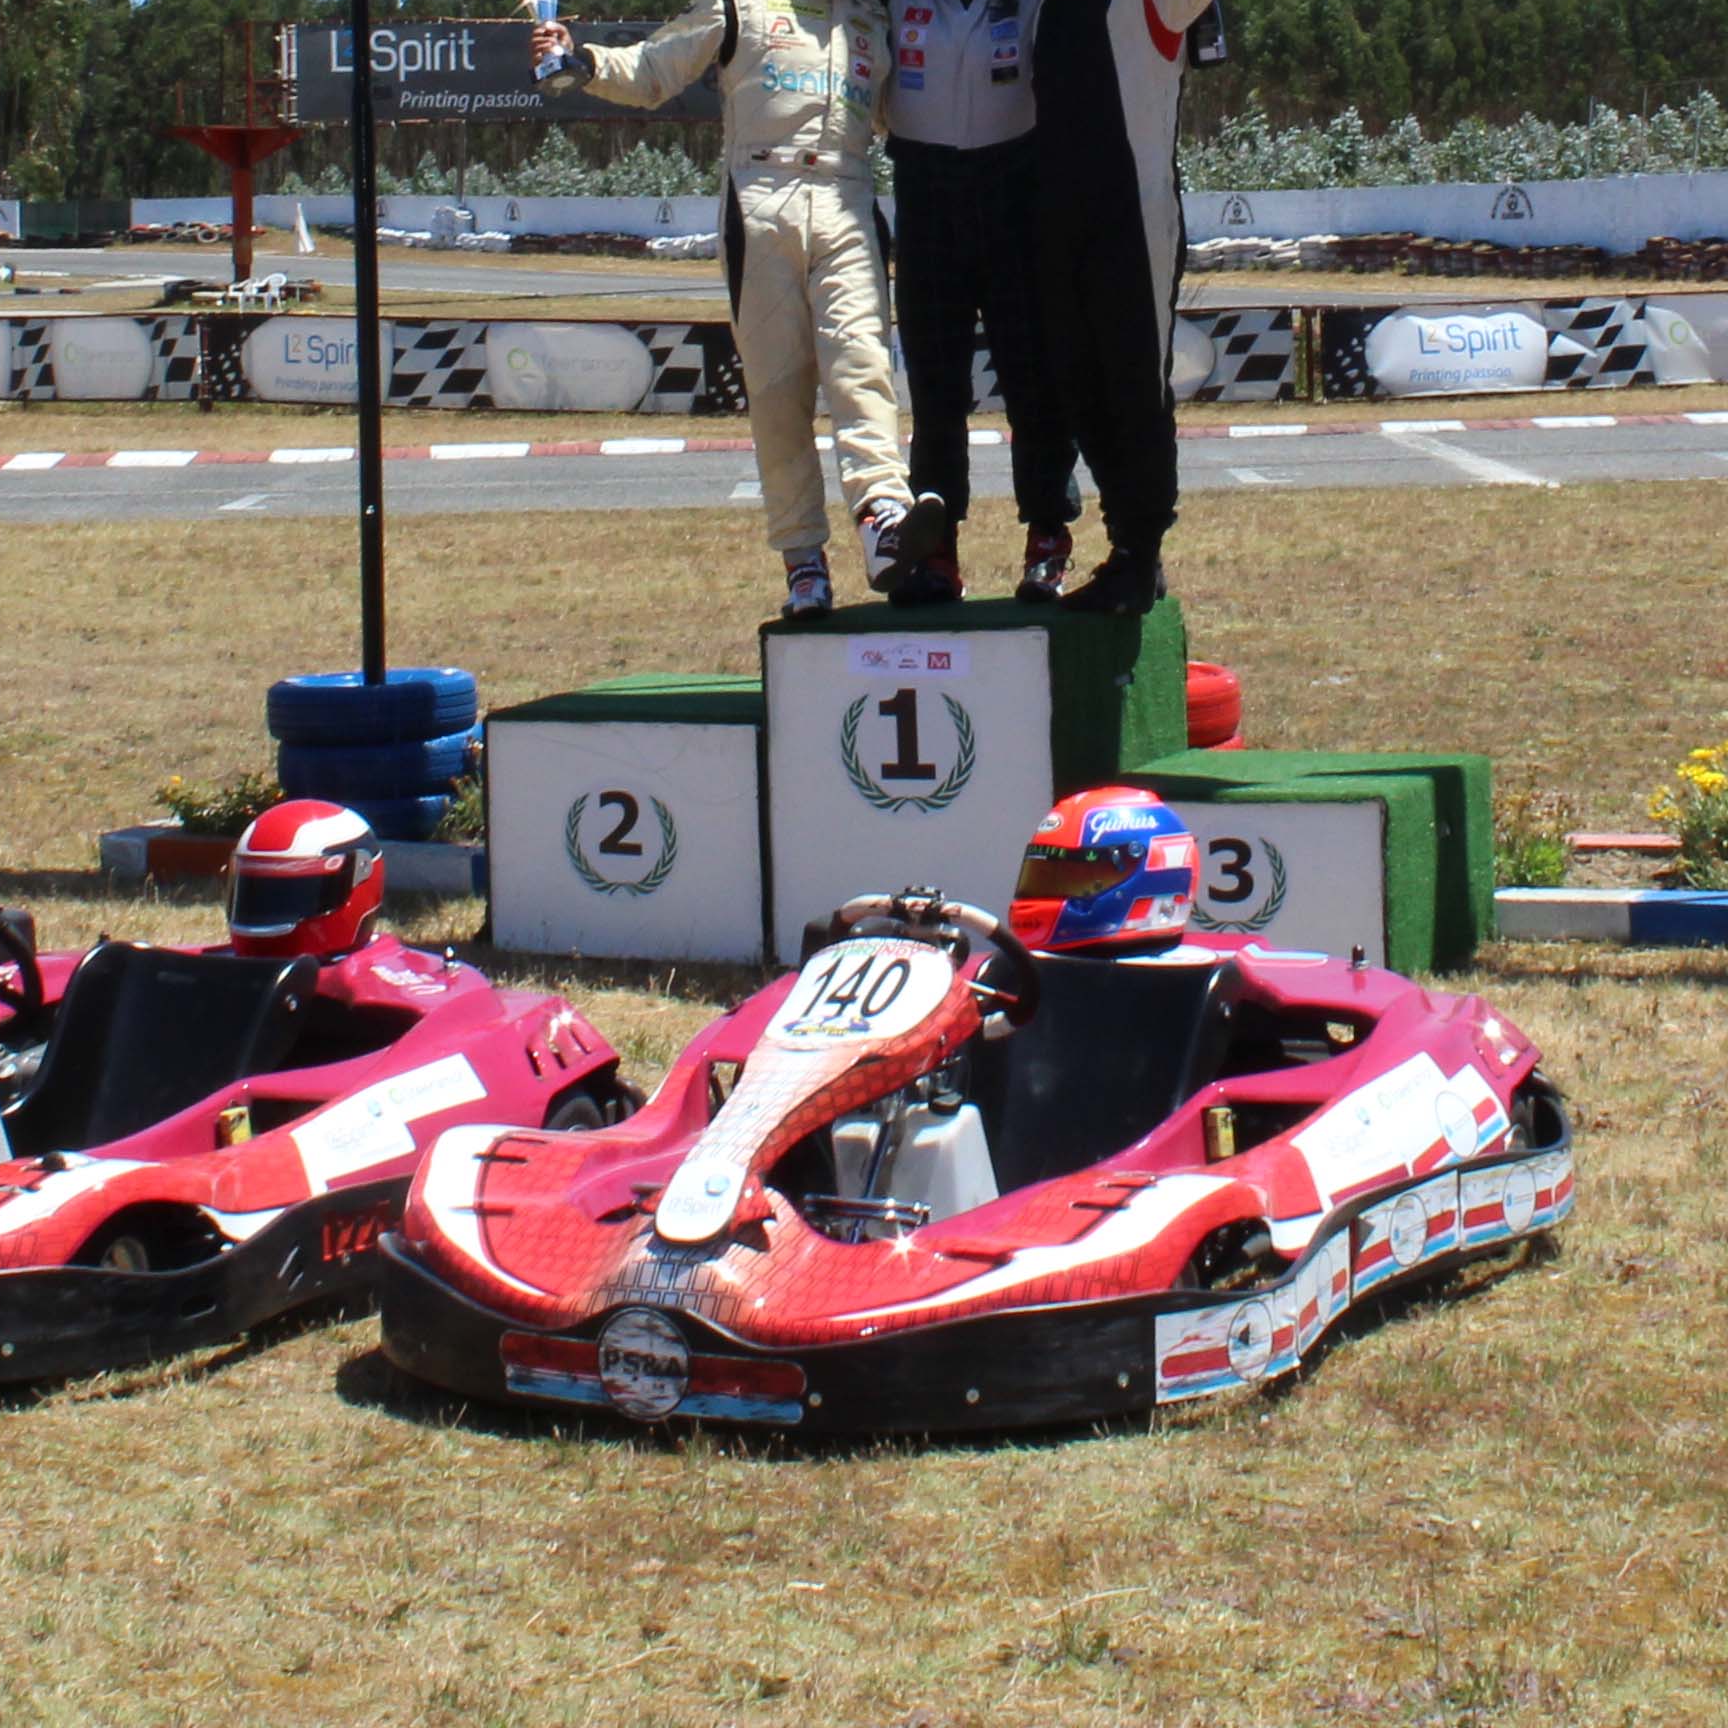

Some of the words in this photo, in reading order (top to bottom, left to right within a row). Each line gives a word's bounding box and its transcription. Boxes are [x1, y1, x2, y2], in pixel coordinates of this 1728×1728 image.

[369, 28, 476, 82] Spirit
[399, 90, 470, 113] Printing
[472, 90, 544, 113] passion.
[306, 334, 358, 370] Spir
[1445, 319, 1522, 360] Spirit
[877, 687, 936, 781] 1
[597, 790, 643, 856] 2
[1206, 837, 1256, 903] 3
[800, 954, 911, 1018] 140
